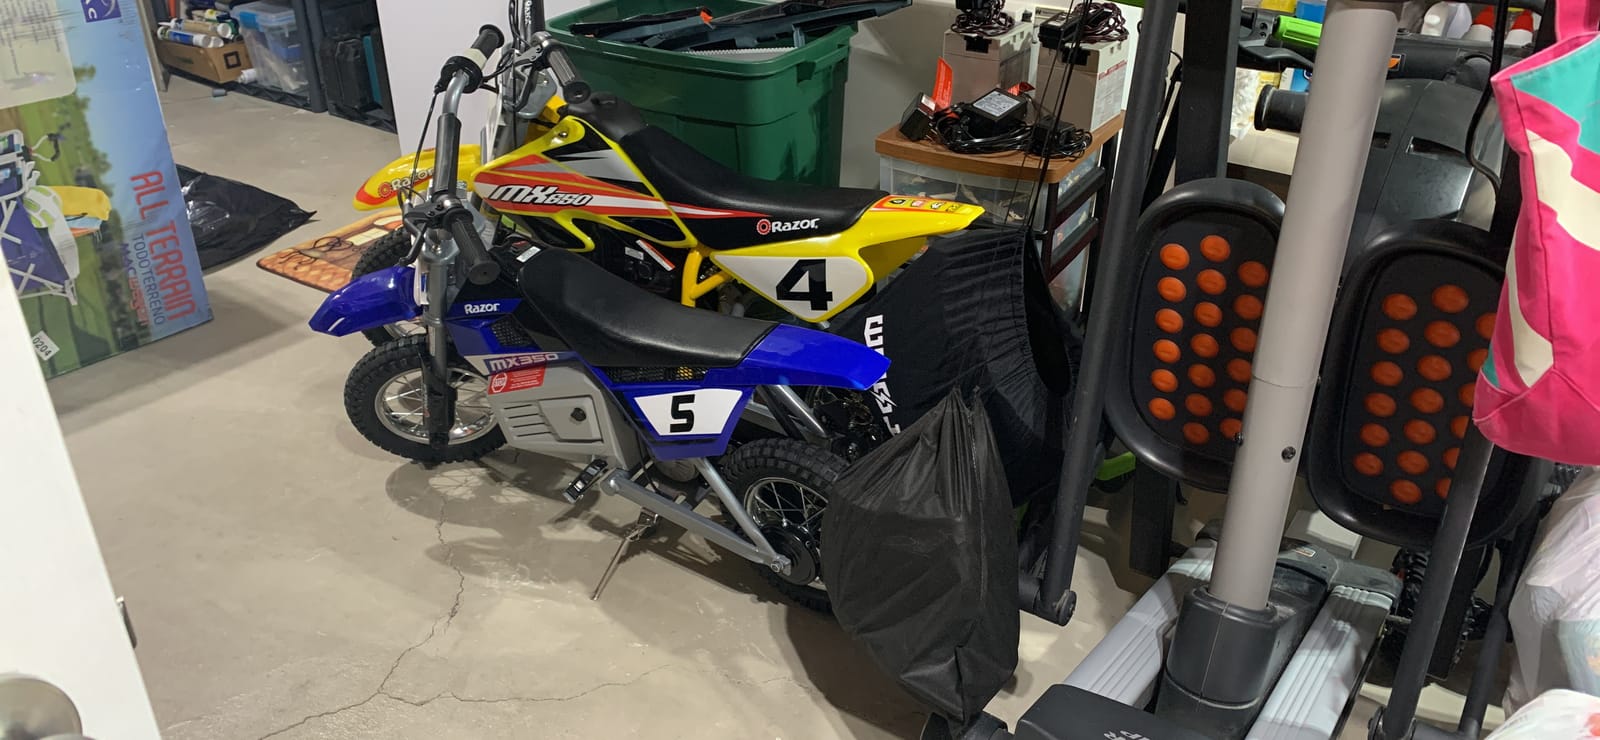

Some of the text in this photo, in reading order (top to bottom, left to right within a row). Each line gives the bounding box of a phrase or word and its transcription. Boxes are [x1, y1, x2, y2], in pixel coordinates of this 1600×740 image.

[489, 184, 594, 207] MX650
[771, 218, 820, 233] Razor
[130, 170, 197, 321] ALL TERRAIN
[775, 259, 833, 311] 4
[464, 303, 501, 315] Razor
[32, 337, 52, 356] 0204
[489, 353, 560, 373] MX350
[669, 394, 696, 434] 5
